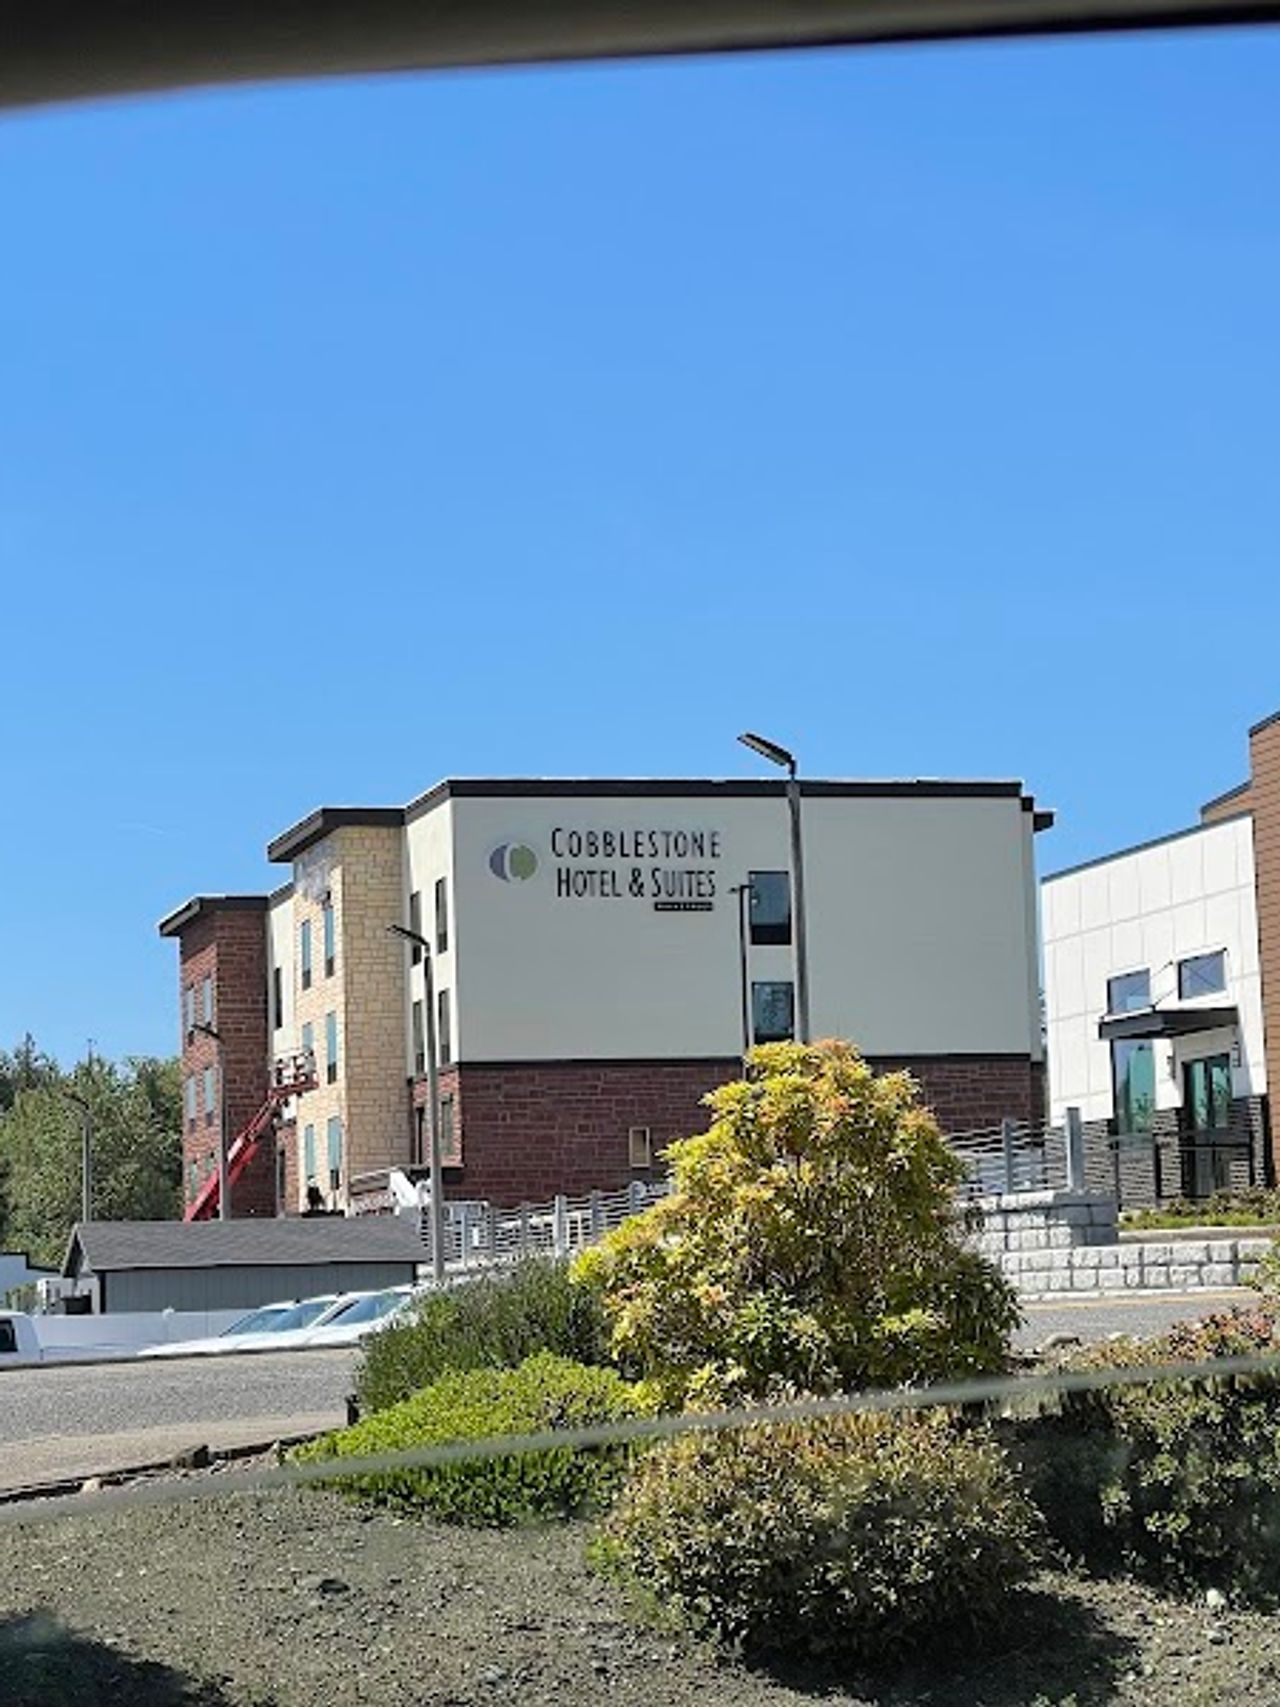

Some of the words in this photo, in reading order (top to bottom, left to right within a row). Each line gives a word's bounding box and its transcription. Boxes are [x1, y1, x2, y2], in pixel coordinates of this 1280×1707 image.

[551, 828, 721, 858] COBBLESTONE
[557, 867, 622, 897] HOTEL
[628, 867, 645, 897] &
[651, 868, 716, 897] SUITES
